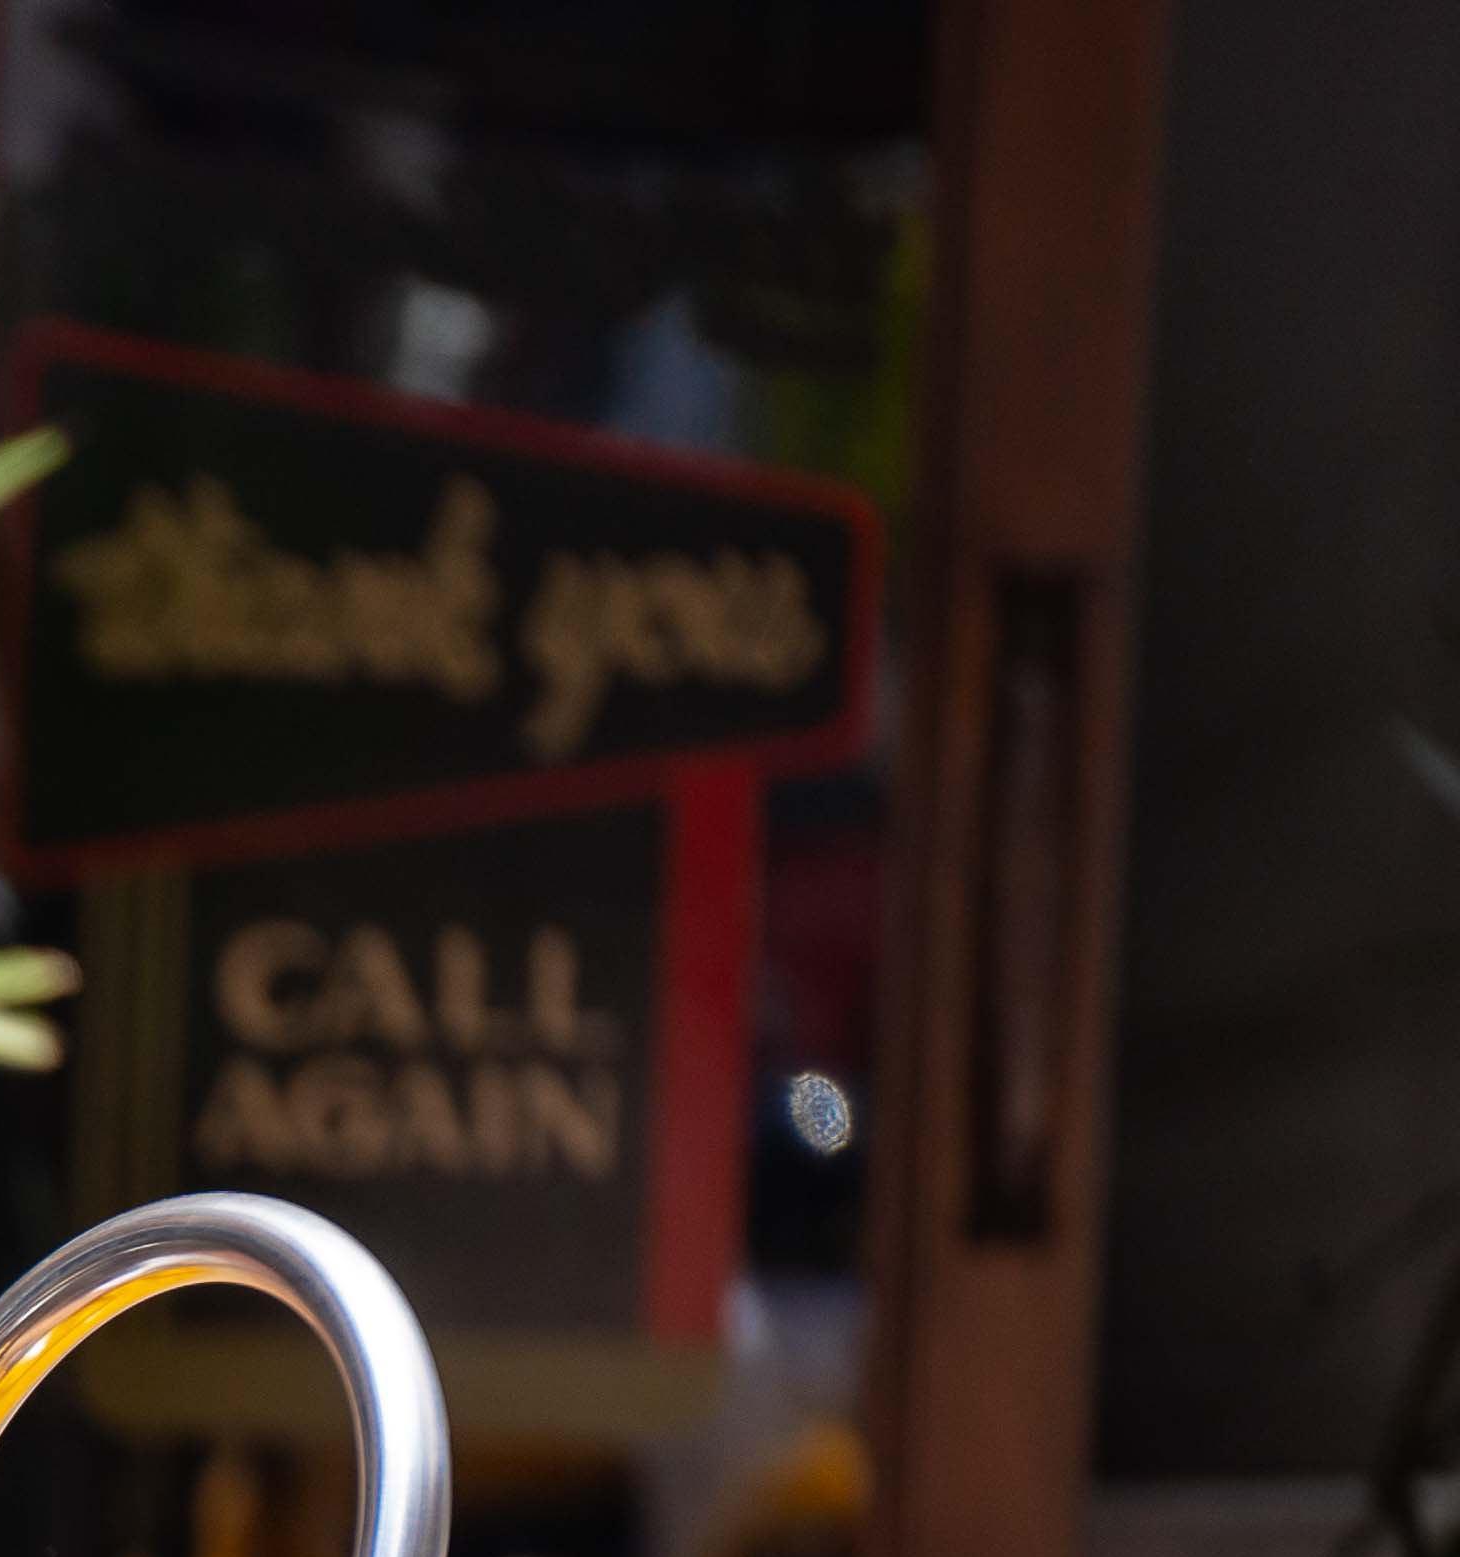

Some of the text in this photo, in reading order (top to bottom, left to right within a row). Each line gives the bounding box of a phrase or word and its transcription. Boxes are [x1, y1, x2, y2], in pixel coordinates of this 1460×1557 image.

[518, 550, 826, 762] you
[222, 918, 623, 1050] CALL
[194, 1056, 616, 1178] AGAIN
